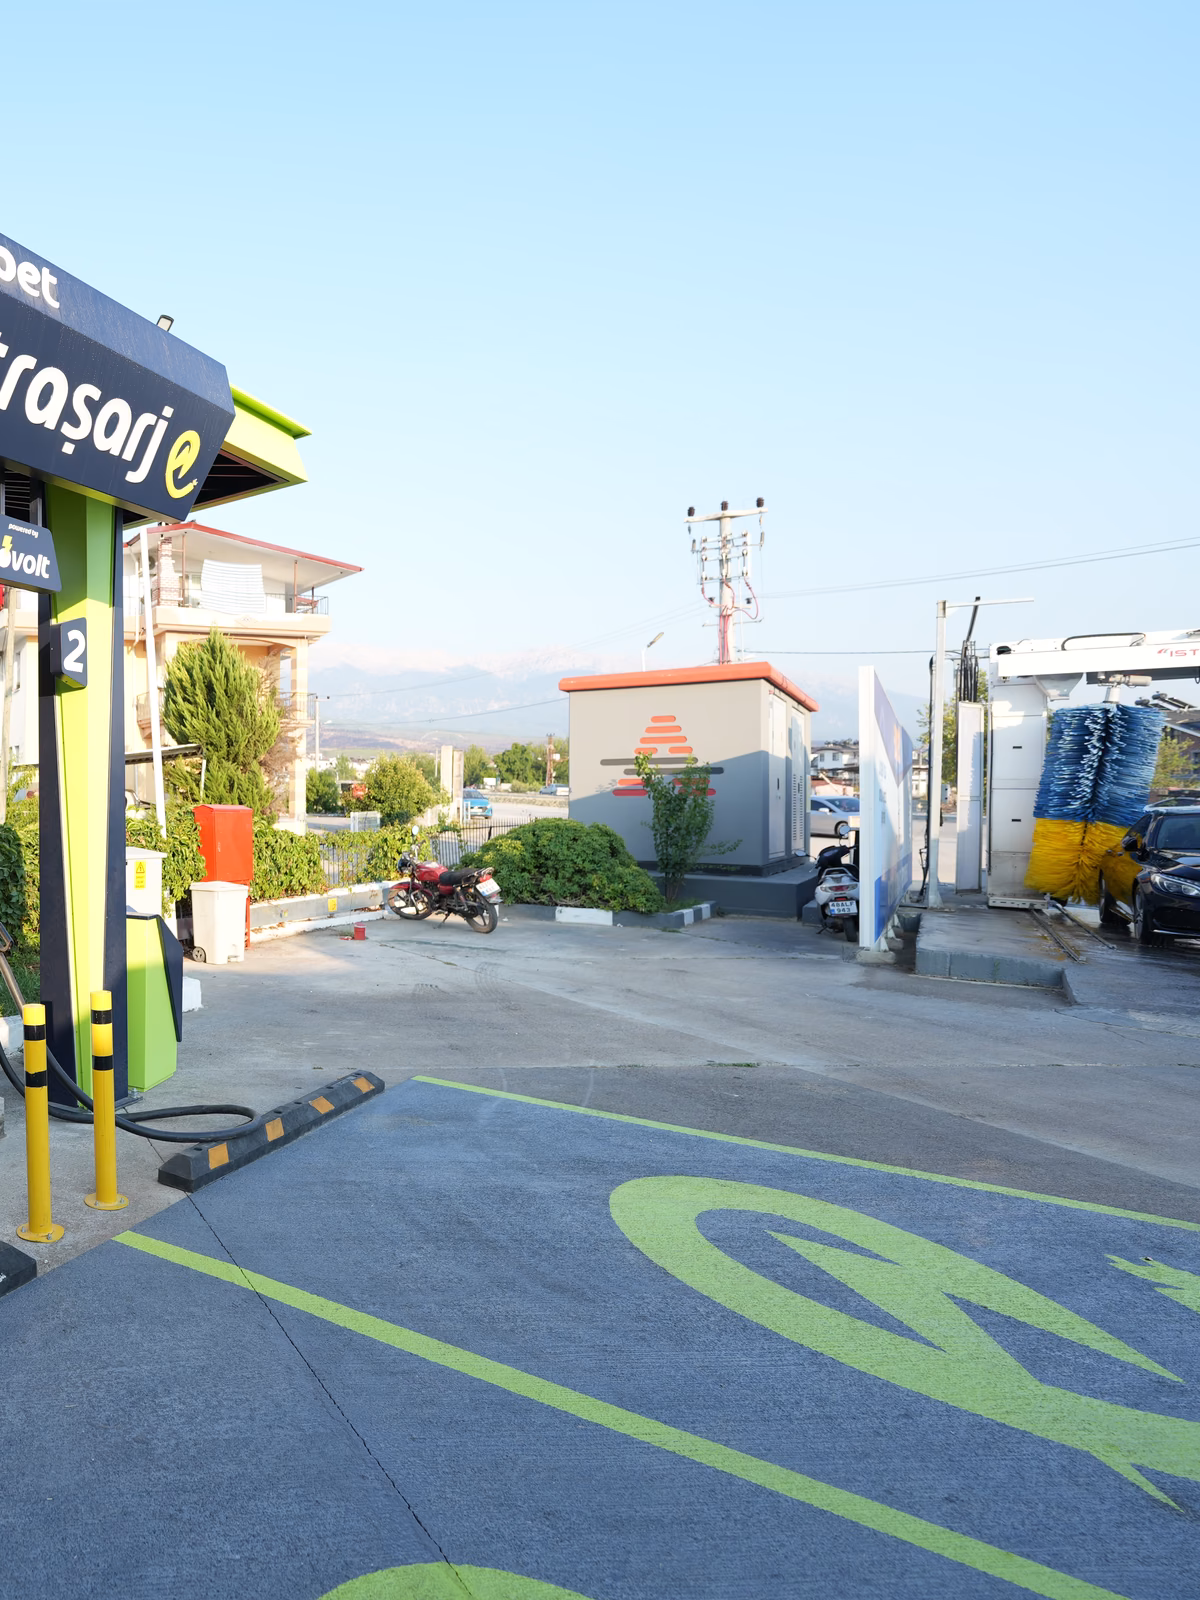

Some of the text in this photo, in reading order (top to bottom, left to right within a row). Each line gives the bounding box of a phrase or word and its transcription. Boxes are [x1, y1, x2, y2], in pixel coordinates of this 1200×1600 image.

[8, 523, 39, 538] powered by
[63, 629, 86, 673] 2
